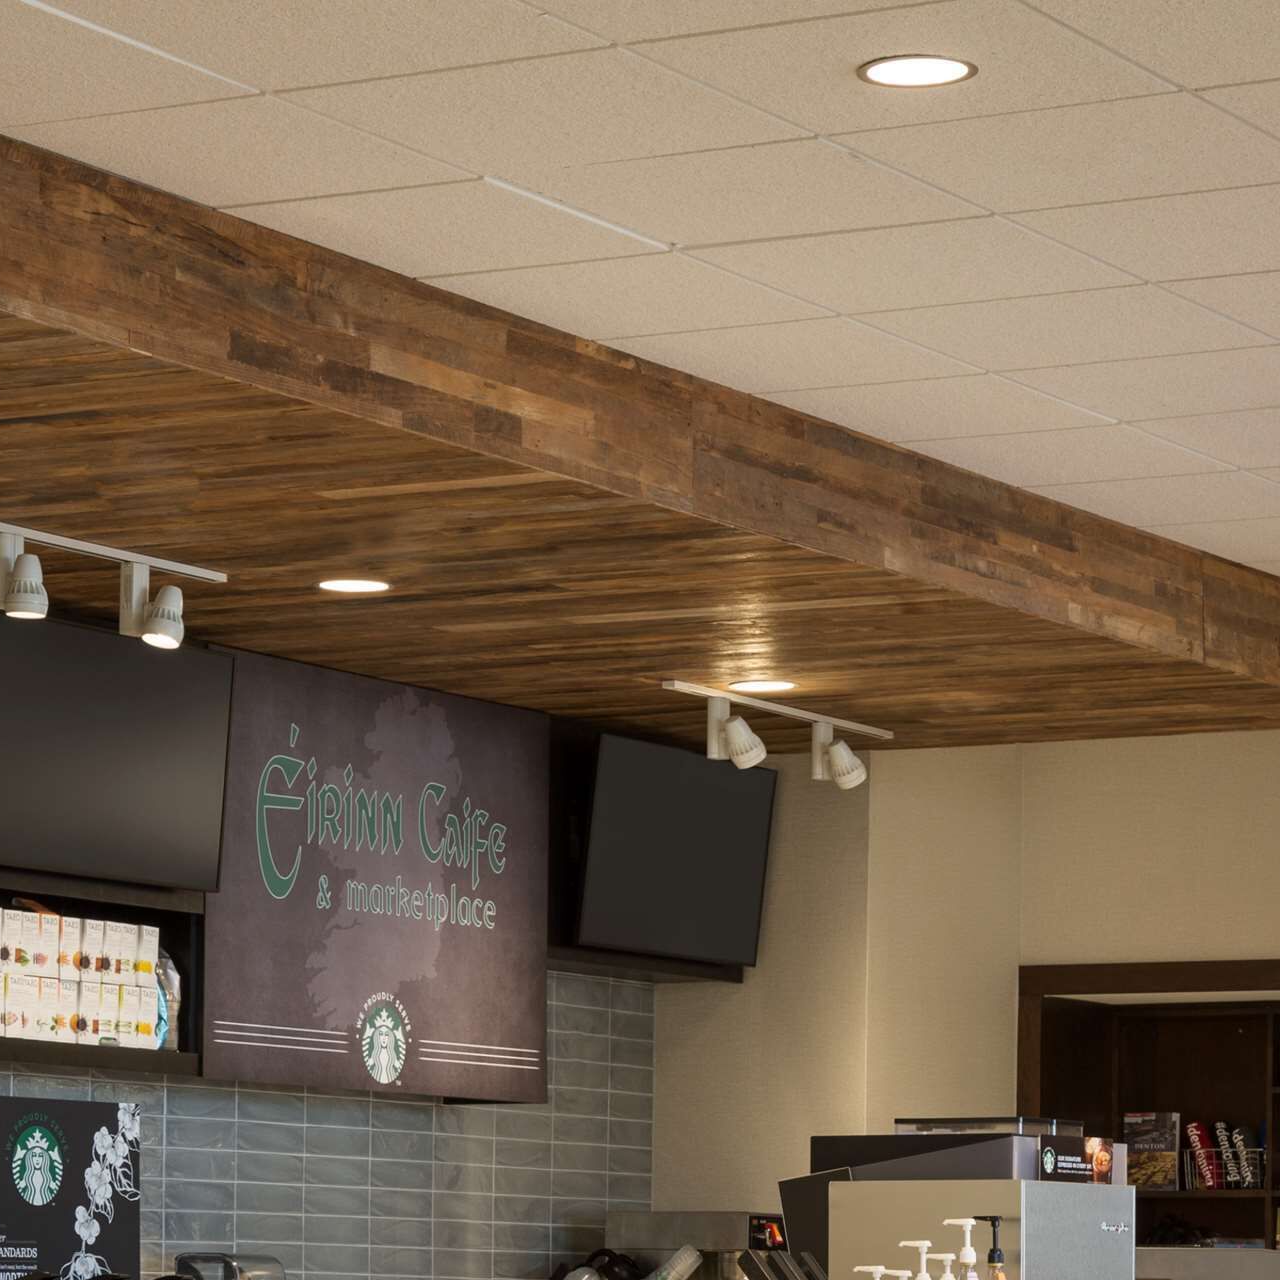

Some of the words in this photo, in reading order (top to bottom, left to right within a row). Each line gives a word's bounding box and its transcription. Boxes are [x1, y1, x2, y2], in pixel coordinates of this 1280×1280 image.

[419, 782, 507, 890] Caife
[316, 874, 331, 910] &
[346, 876, 497, 931] marketplace
[363, 991, 395, 1011] PROUDLY
